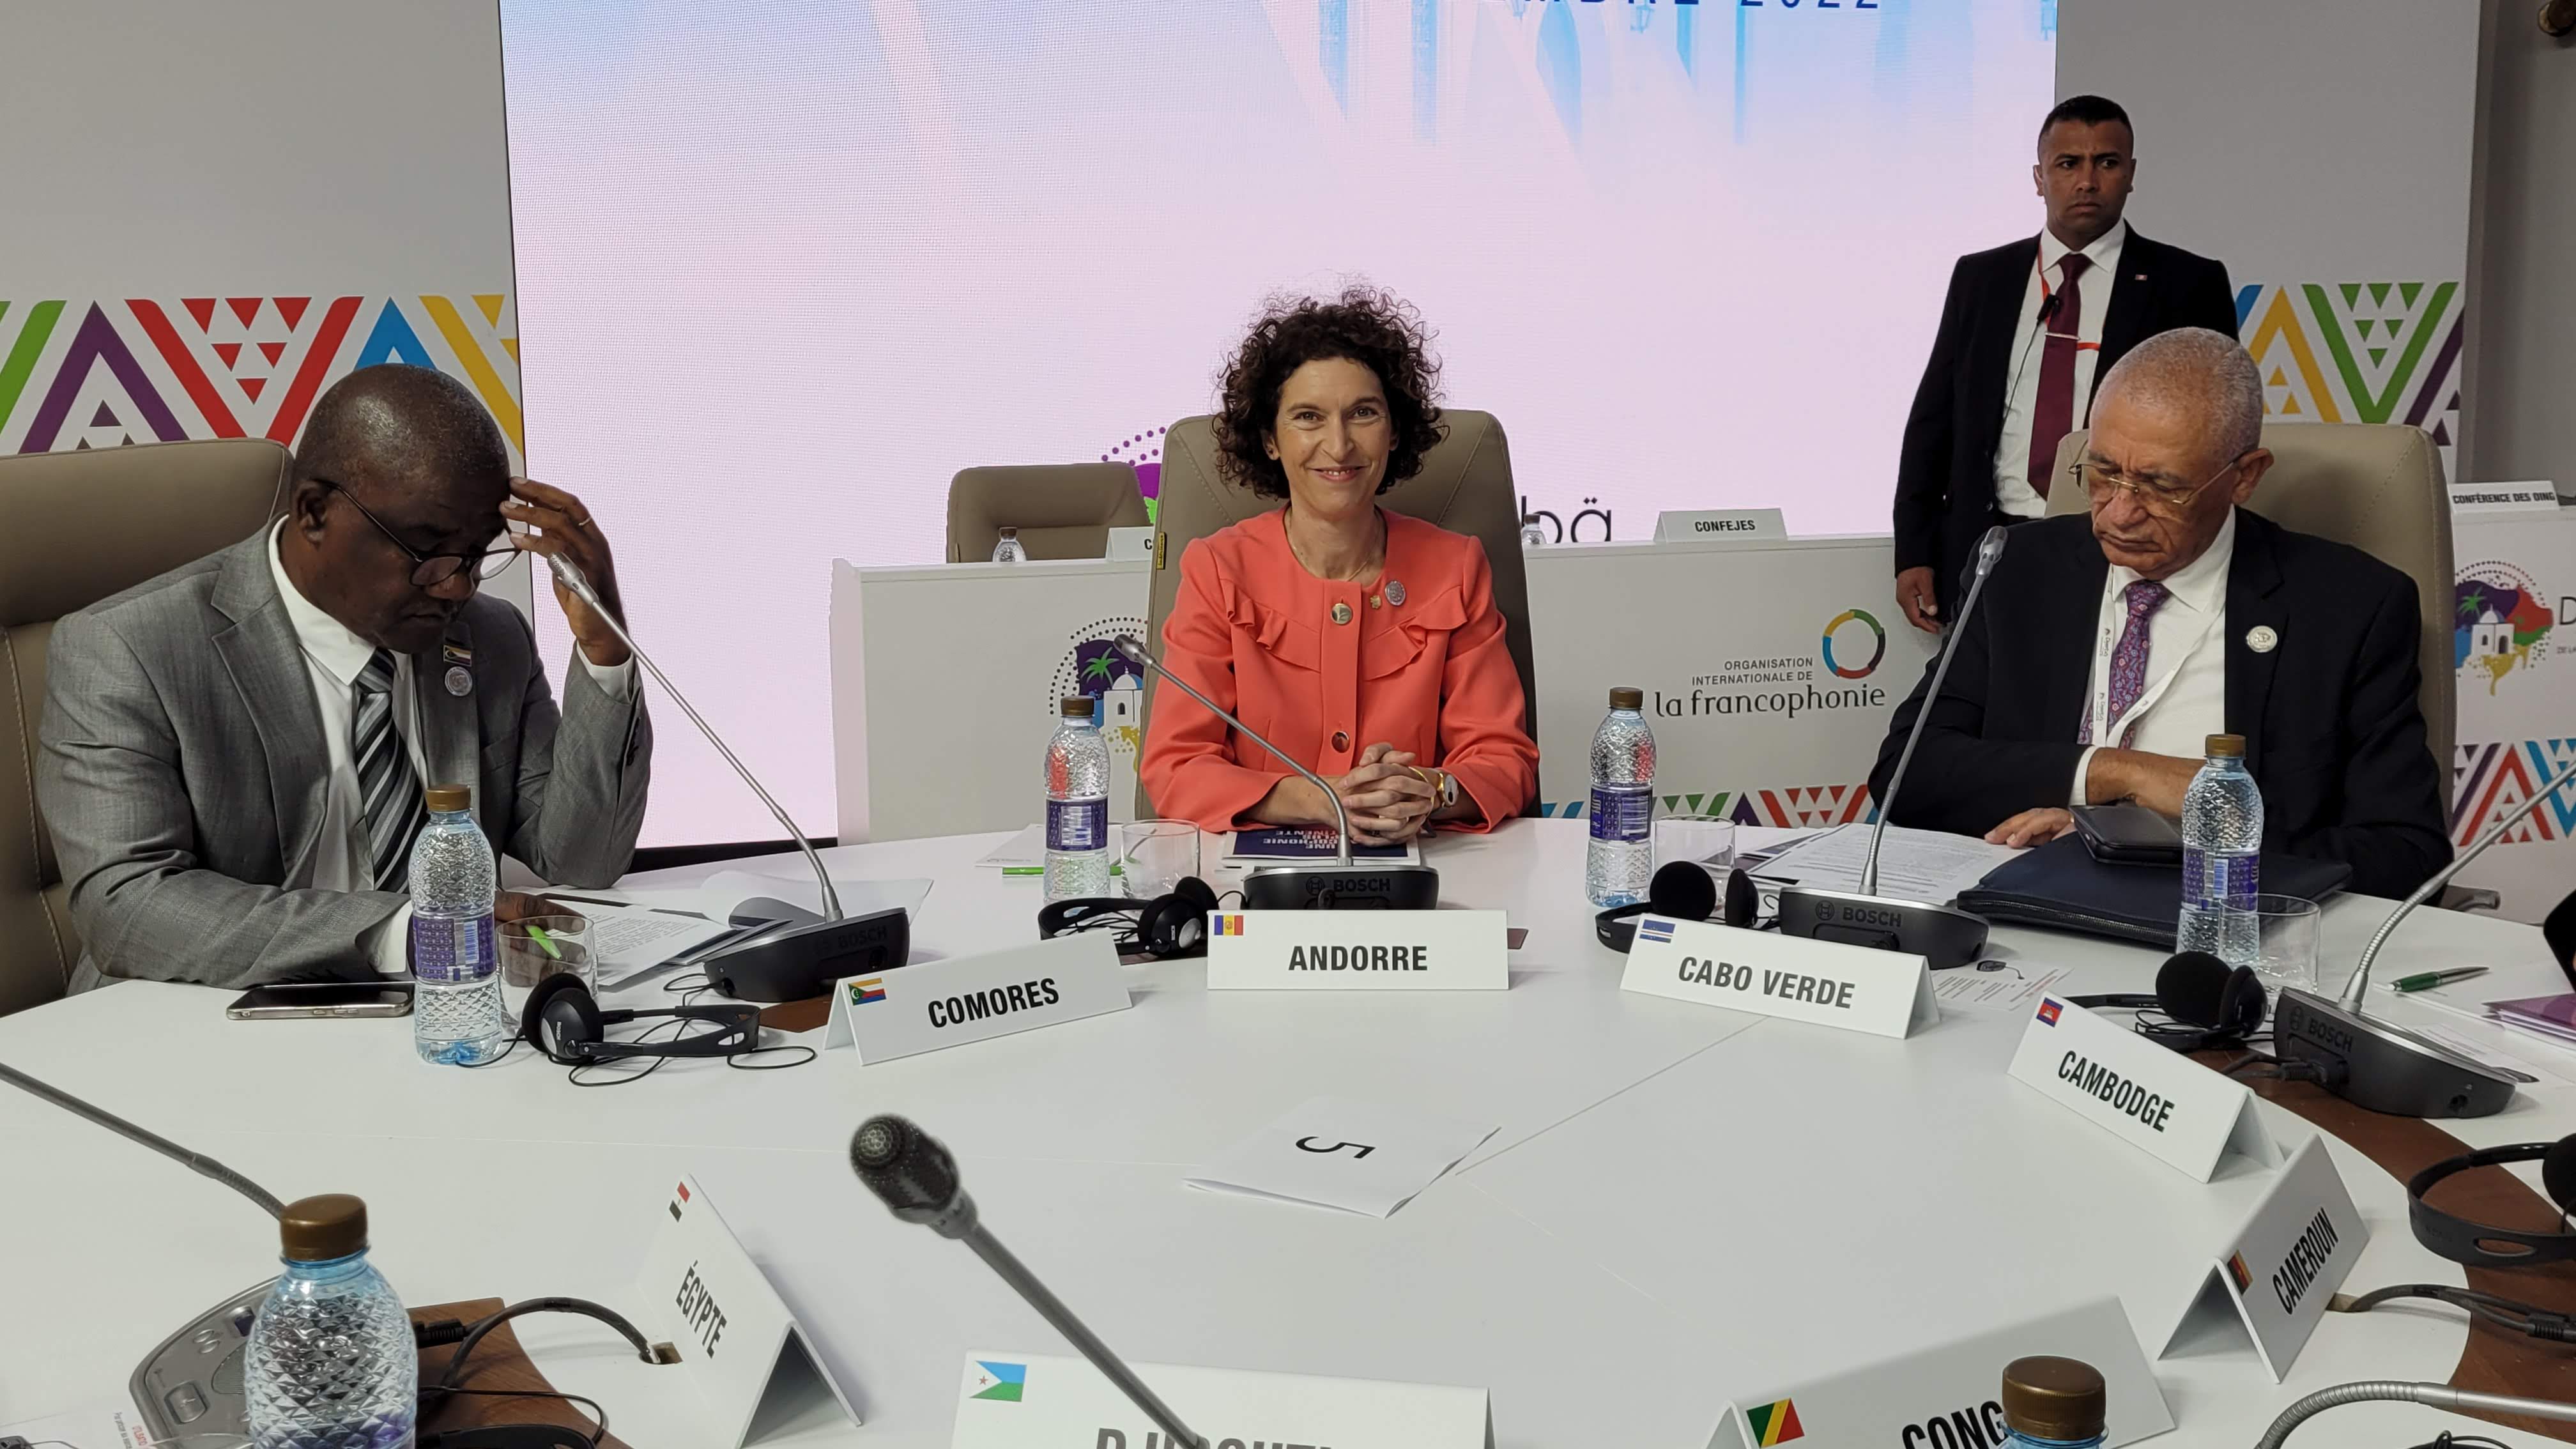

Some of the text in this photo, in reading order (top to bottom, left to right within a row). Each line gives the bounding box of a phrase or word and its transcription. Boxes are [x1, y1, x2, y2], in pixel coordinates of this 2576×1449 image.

[2453, 493, 2511, 504] CONFÉRENCE
[2513, 493, 2531, 502] DES
[1694, 519, 1756, 532] CONFEJES
[1724, 657, 1813, 671] ORGANISATION
[1692, 671, 1813, 686] INTERNATIONALE DE
[1655, 683, 1886, 719] la francophonie
[1333, 877, 1391, 893] BOSCH
[1843, 907, 1903, 928] BOSCH
[838, 926, 887, 949] BOSCH
[1288, 946, 1429, 972] ANDORRE
[1678, 956, 1855, 1009] CABO VERDE
[928, 977, 1060, 1029] COMORES
[2308, 1021, 2353, 1054] BOSCH
[2057, 1050, 2175, 1133] CAMBODGE
[1296, 1136, 1376, 1160] 5
[2272, 1206, 2340, 1315] CAMEROUN
[675, 1259, 728, 1360] ÉGYPTE
[1902, 1400, 2009, 1449] CONG
